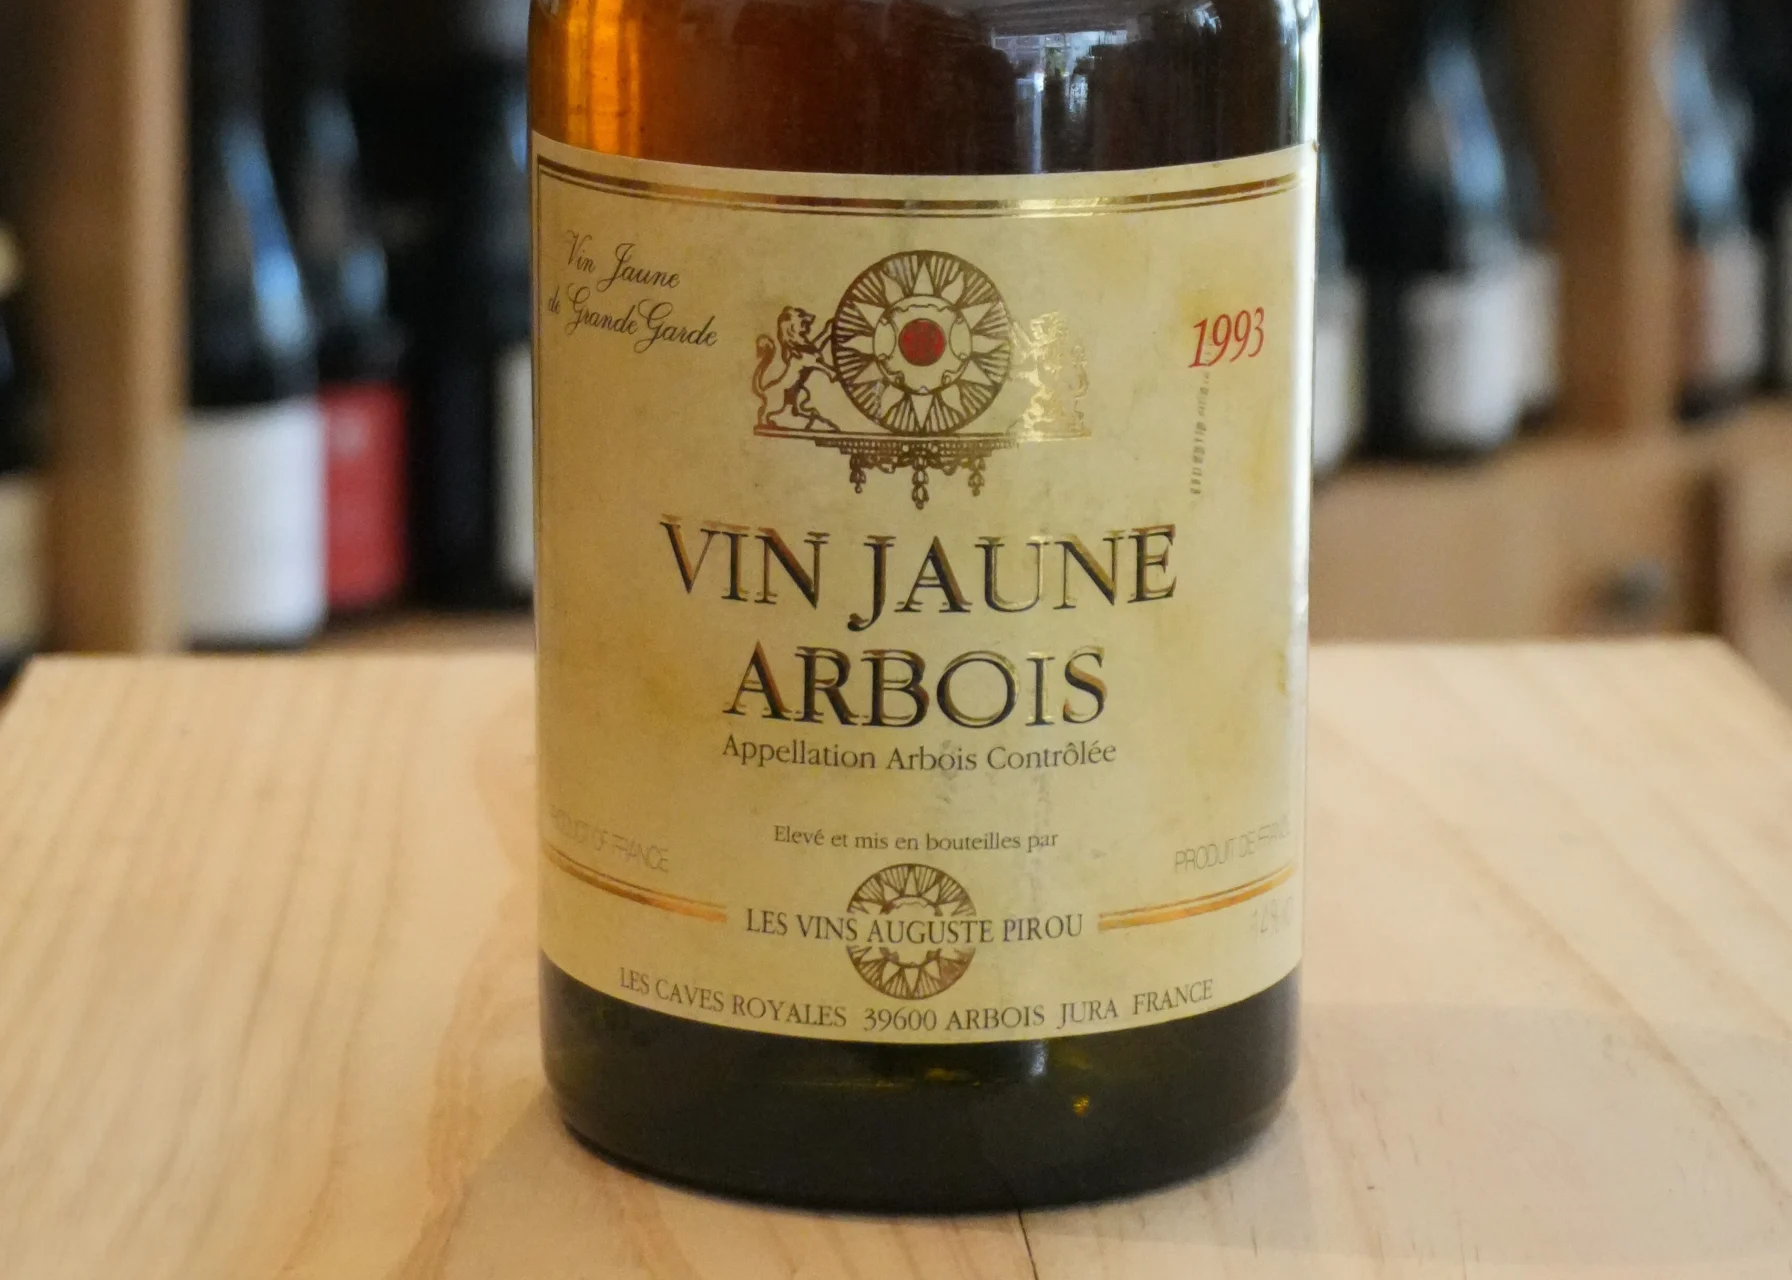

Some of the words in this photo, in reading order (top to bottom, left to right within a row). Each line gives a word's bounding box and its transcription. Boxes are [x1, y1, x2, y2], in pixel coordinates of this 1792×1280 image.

[567, 229, 596, 273] Vin
[596, 242, 681, 293] Jaune
[564, 282, 640, 336] Grande
[633, 298, 719, 354] Garde
[1189, 306, 1265, 368] 1993
[659, 513, 830, 610] VIN
[847, 523, 1177, 632] JAUNE
[721, 640, 1108, 729] ARBOIS
[722, 733, 876, 767] Appellation
[885, 745, 978, 771] Arbois
[986, 740, 1117, 770] Contrôlée
[773, 824, 825, 846] Elevé
[830, 832, 849, 848] et
[854, 831, 889, 850] mis
[894, 835, 919, 850] en
[925, 831, 1022, 852] bouteilles
[1027, 833, 1058, 853] par
[746, 907, 789, 937] LES
[796, 914, 858, 942] VINS
[866, 918, 994, 945] AUGUSTE
[1002, 912, 1083, 943] PIROU
[619, 966, 651, 995] LES
[655, 978, 725, 1013] CAVES
[731, 993, 848, 1028] ROYALES
[863, 1006, 937, 1033] 39600
[944, 1004, 1046, 1032] ARBOIS
[1056, 996, 1119, 1030] JURA
[1131, 978, 1214, 1016] FRANCE
